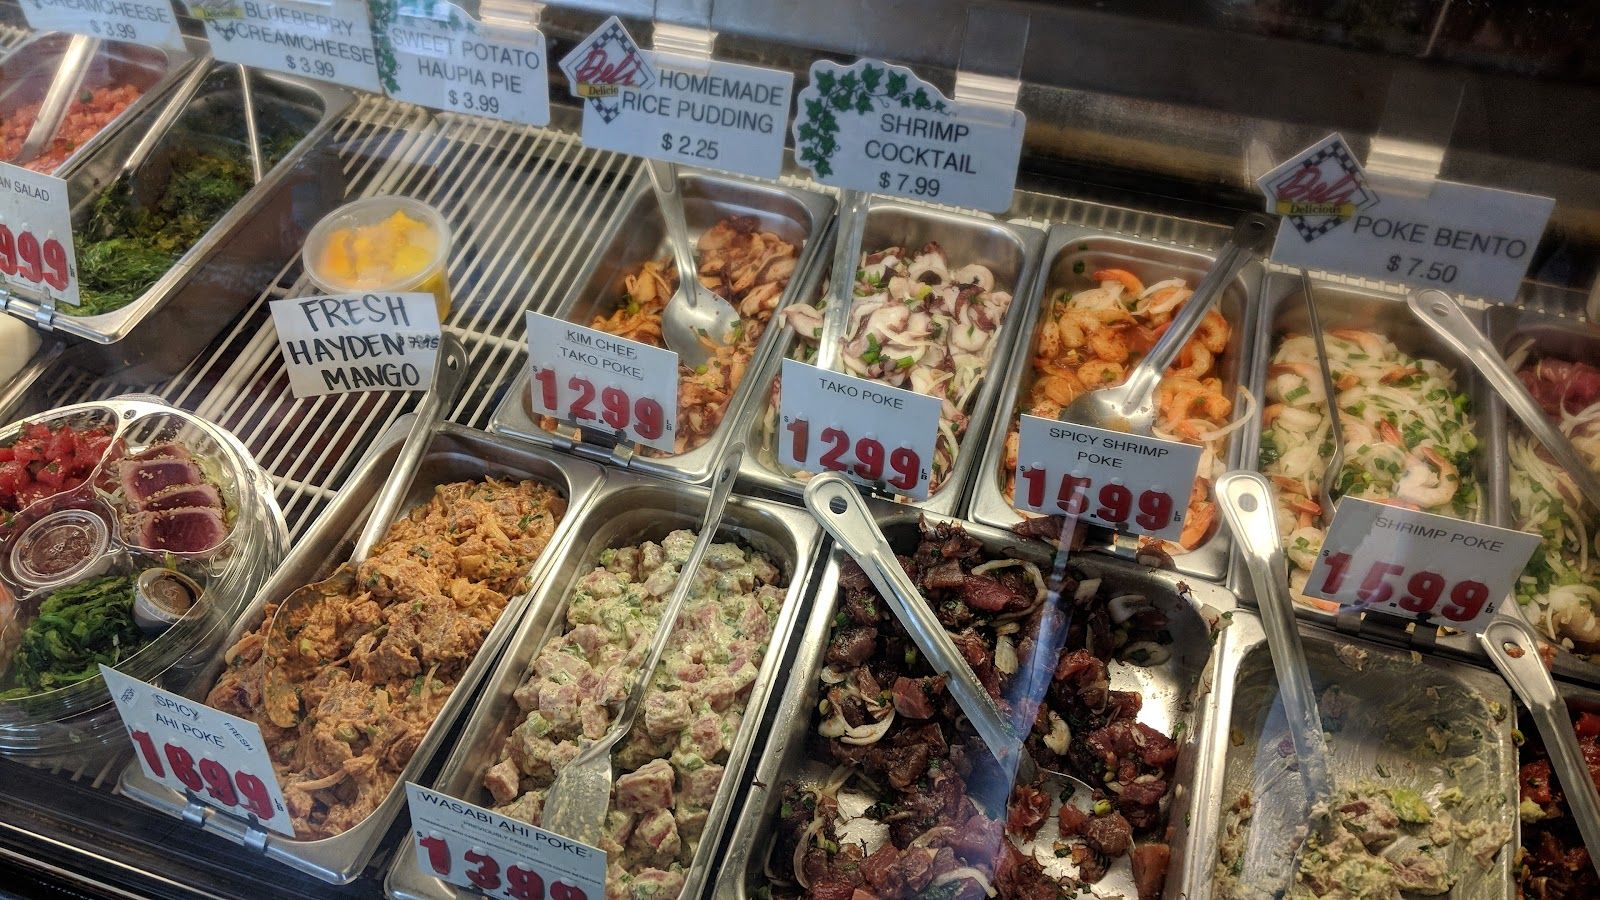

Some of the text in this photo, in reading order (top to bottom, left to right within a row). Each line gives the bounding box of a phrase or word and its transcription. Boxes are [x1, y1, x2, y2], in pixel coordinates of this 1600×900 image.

[103, 22, 137, 40] 3.99
[235, 22, 376, 66] CREAMCHEESE
[391, 27, 540, 71] SWEET POTATO
[301, 57, 336, 79] 3.99
[417, 57, 522, 94] HAUPIA PIE
[463, 92, 500, 114] 3.99
[659, 68, 784, 107] HOMEMADE
[622, 90, 774, 134] RICE PUDDING
[880, 113, 969, 143] SHRIMP
[677, 135, 719, 161] 2.25
[864, 140, 977, 175] COCKTAIL
[14, 180, 50, 202] SALAD
[898, 174, 941, 197] 7.99
[1353, 215, 1528, 259] POKE BENTO
[1407, 257, 1457, 284] 7.50
[298, 293, 411, 333] FRESH
[286, 332, 405, 366] HAYDEN
[567, 329, 637, 359] KIM CHEE
[320, 362, 420, 391] MANGO
[560, 346, 643, 380] TAKO POKE
[819, 377, 904, 411] TAKO POKE
[1049, 427, 1170, 459] SPICY SHRIMP
[1077, 451, 1124, 469] POKE
[1374, 516, 1505, 553] SHRIMP POKE
[153, 693, 199, 722] SPICY
[156, 713, 225, 750] AHI POKE
[223, 721, 254, 751] FRESH
[421, 791, 589, 858] WASABI AHI POKE
